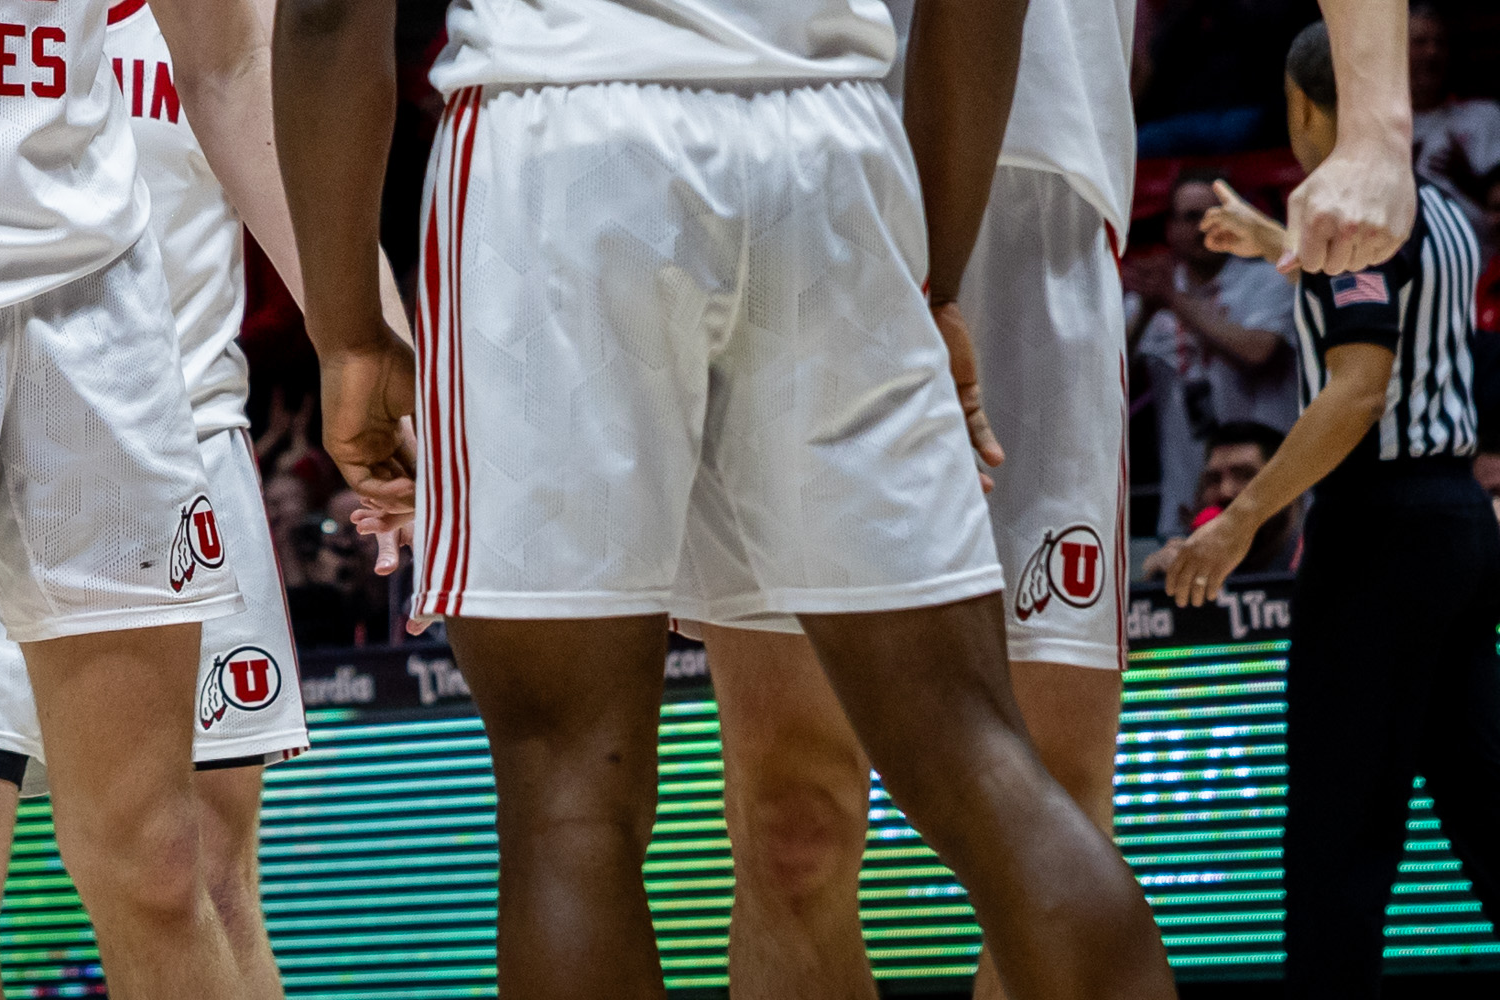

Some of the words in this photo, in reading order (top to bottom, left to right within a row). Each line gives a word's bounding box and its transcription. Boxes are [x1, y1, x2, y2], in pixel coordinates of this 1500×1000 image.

[193, 510, 222, 560] U
[1061, 542, 1098, 598] U
[229, 659, 269, 703] U
